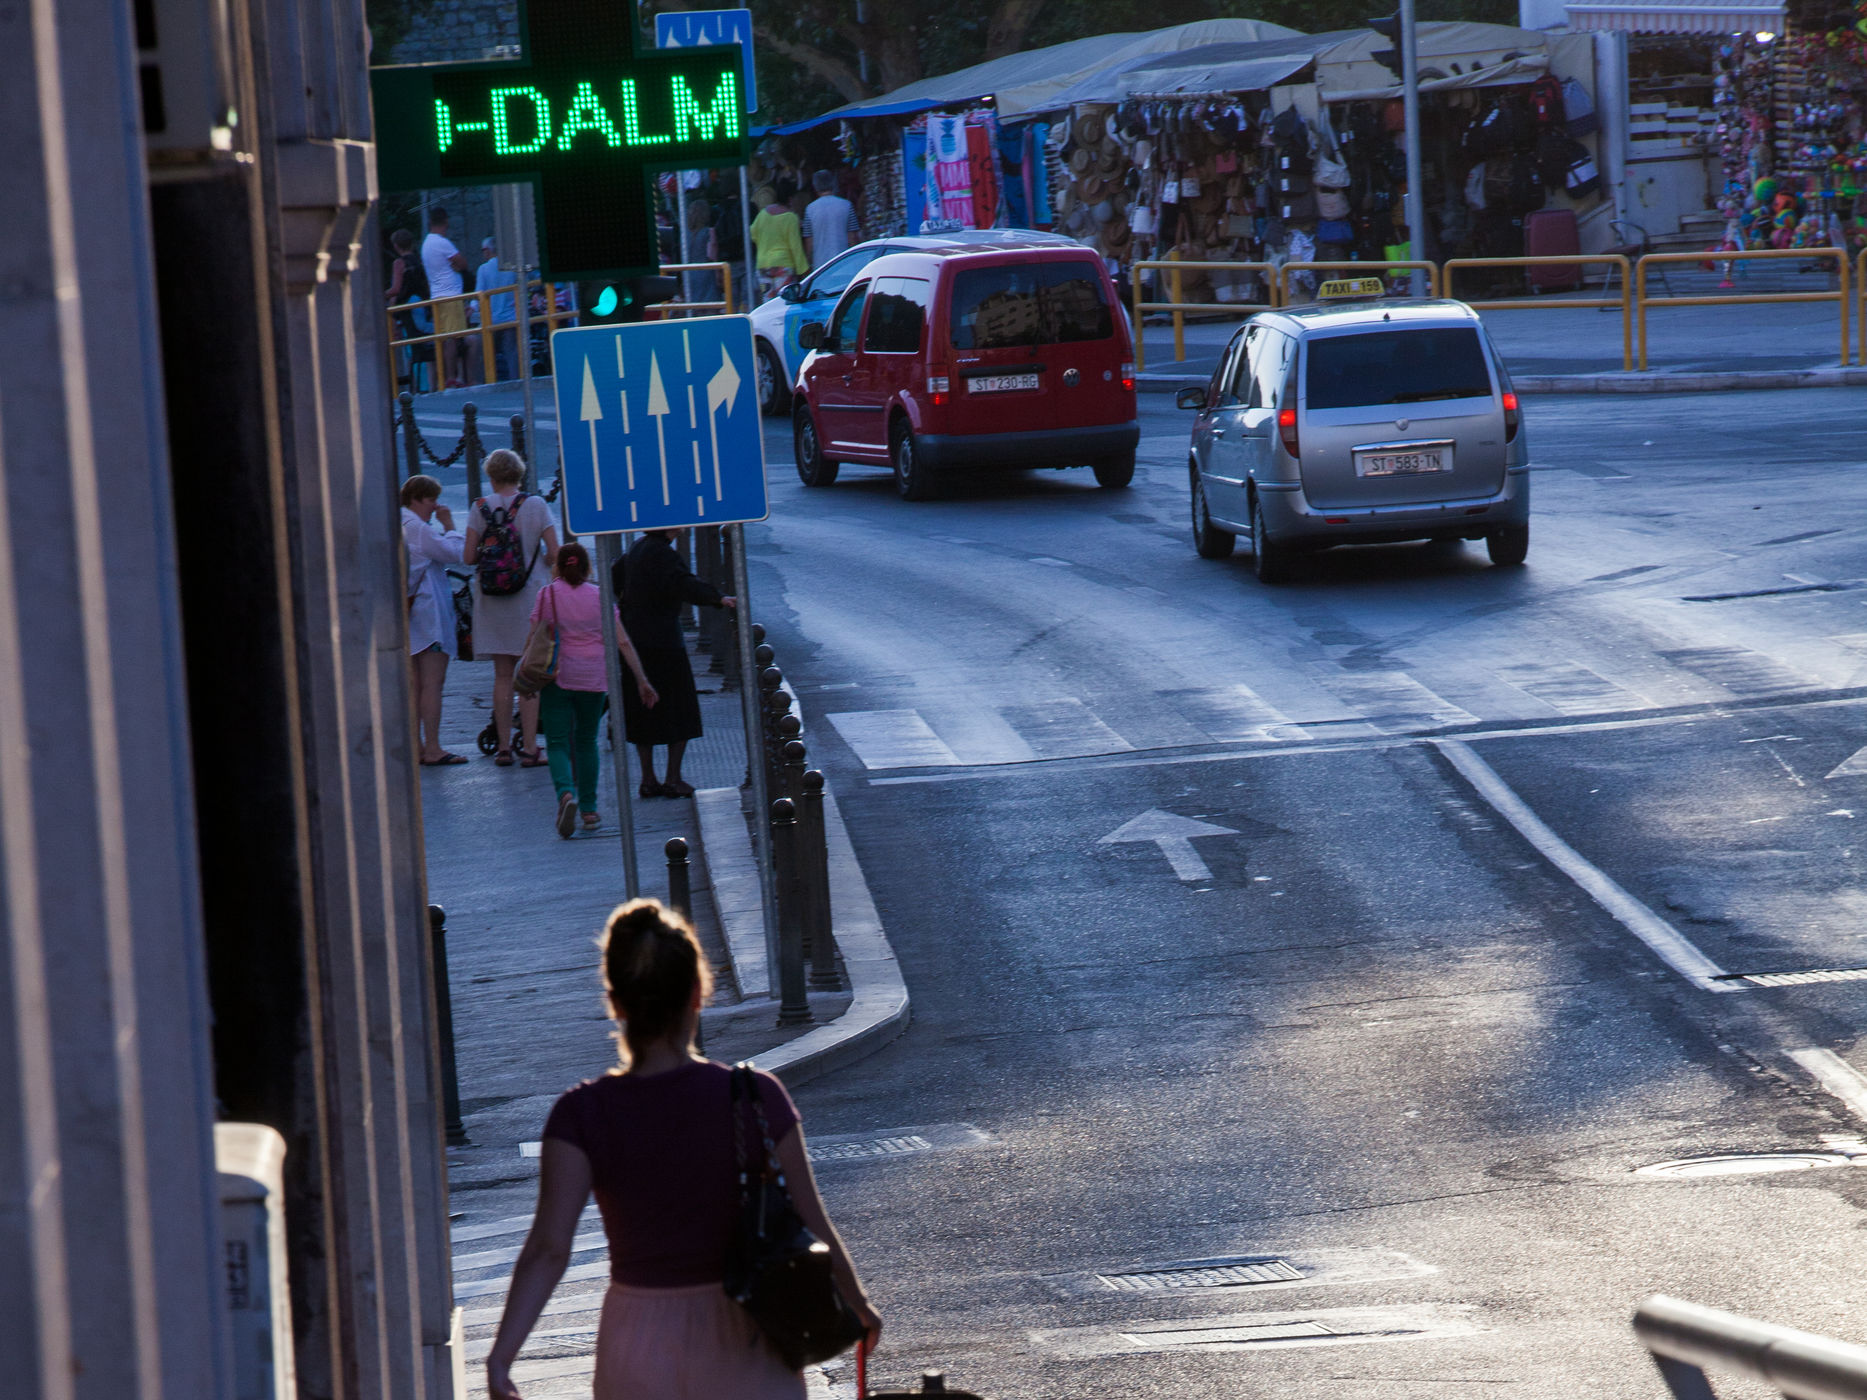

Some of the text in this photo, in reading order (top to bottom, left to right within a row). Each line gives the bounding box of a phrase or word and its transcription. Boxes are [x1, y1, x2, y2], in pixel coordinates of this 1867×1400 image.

[1325, 279, 1379, 294] TAXI 159
[975, 379, 988, 391] ST
[1372, 454, 1441, 471] ST 583-TN
